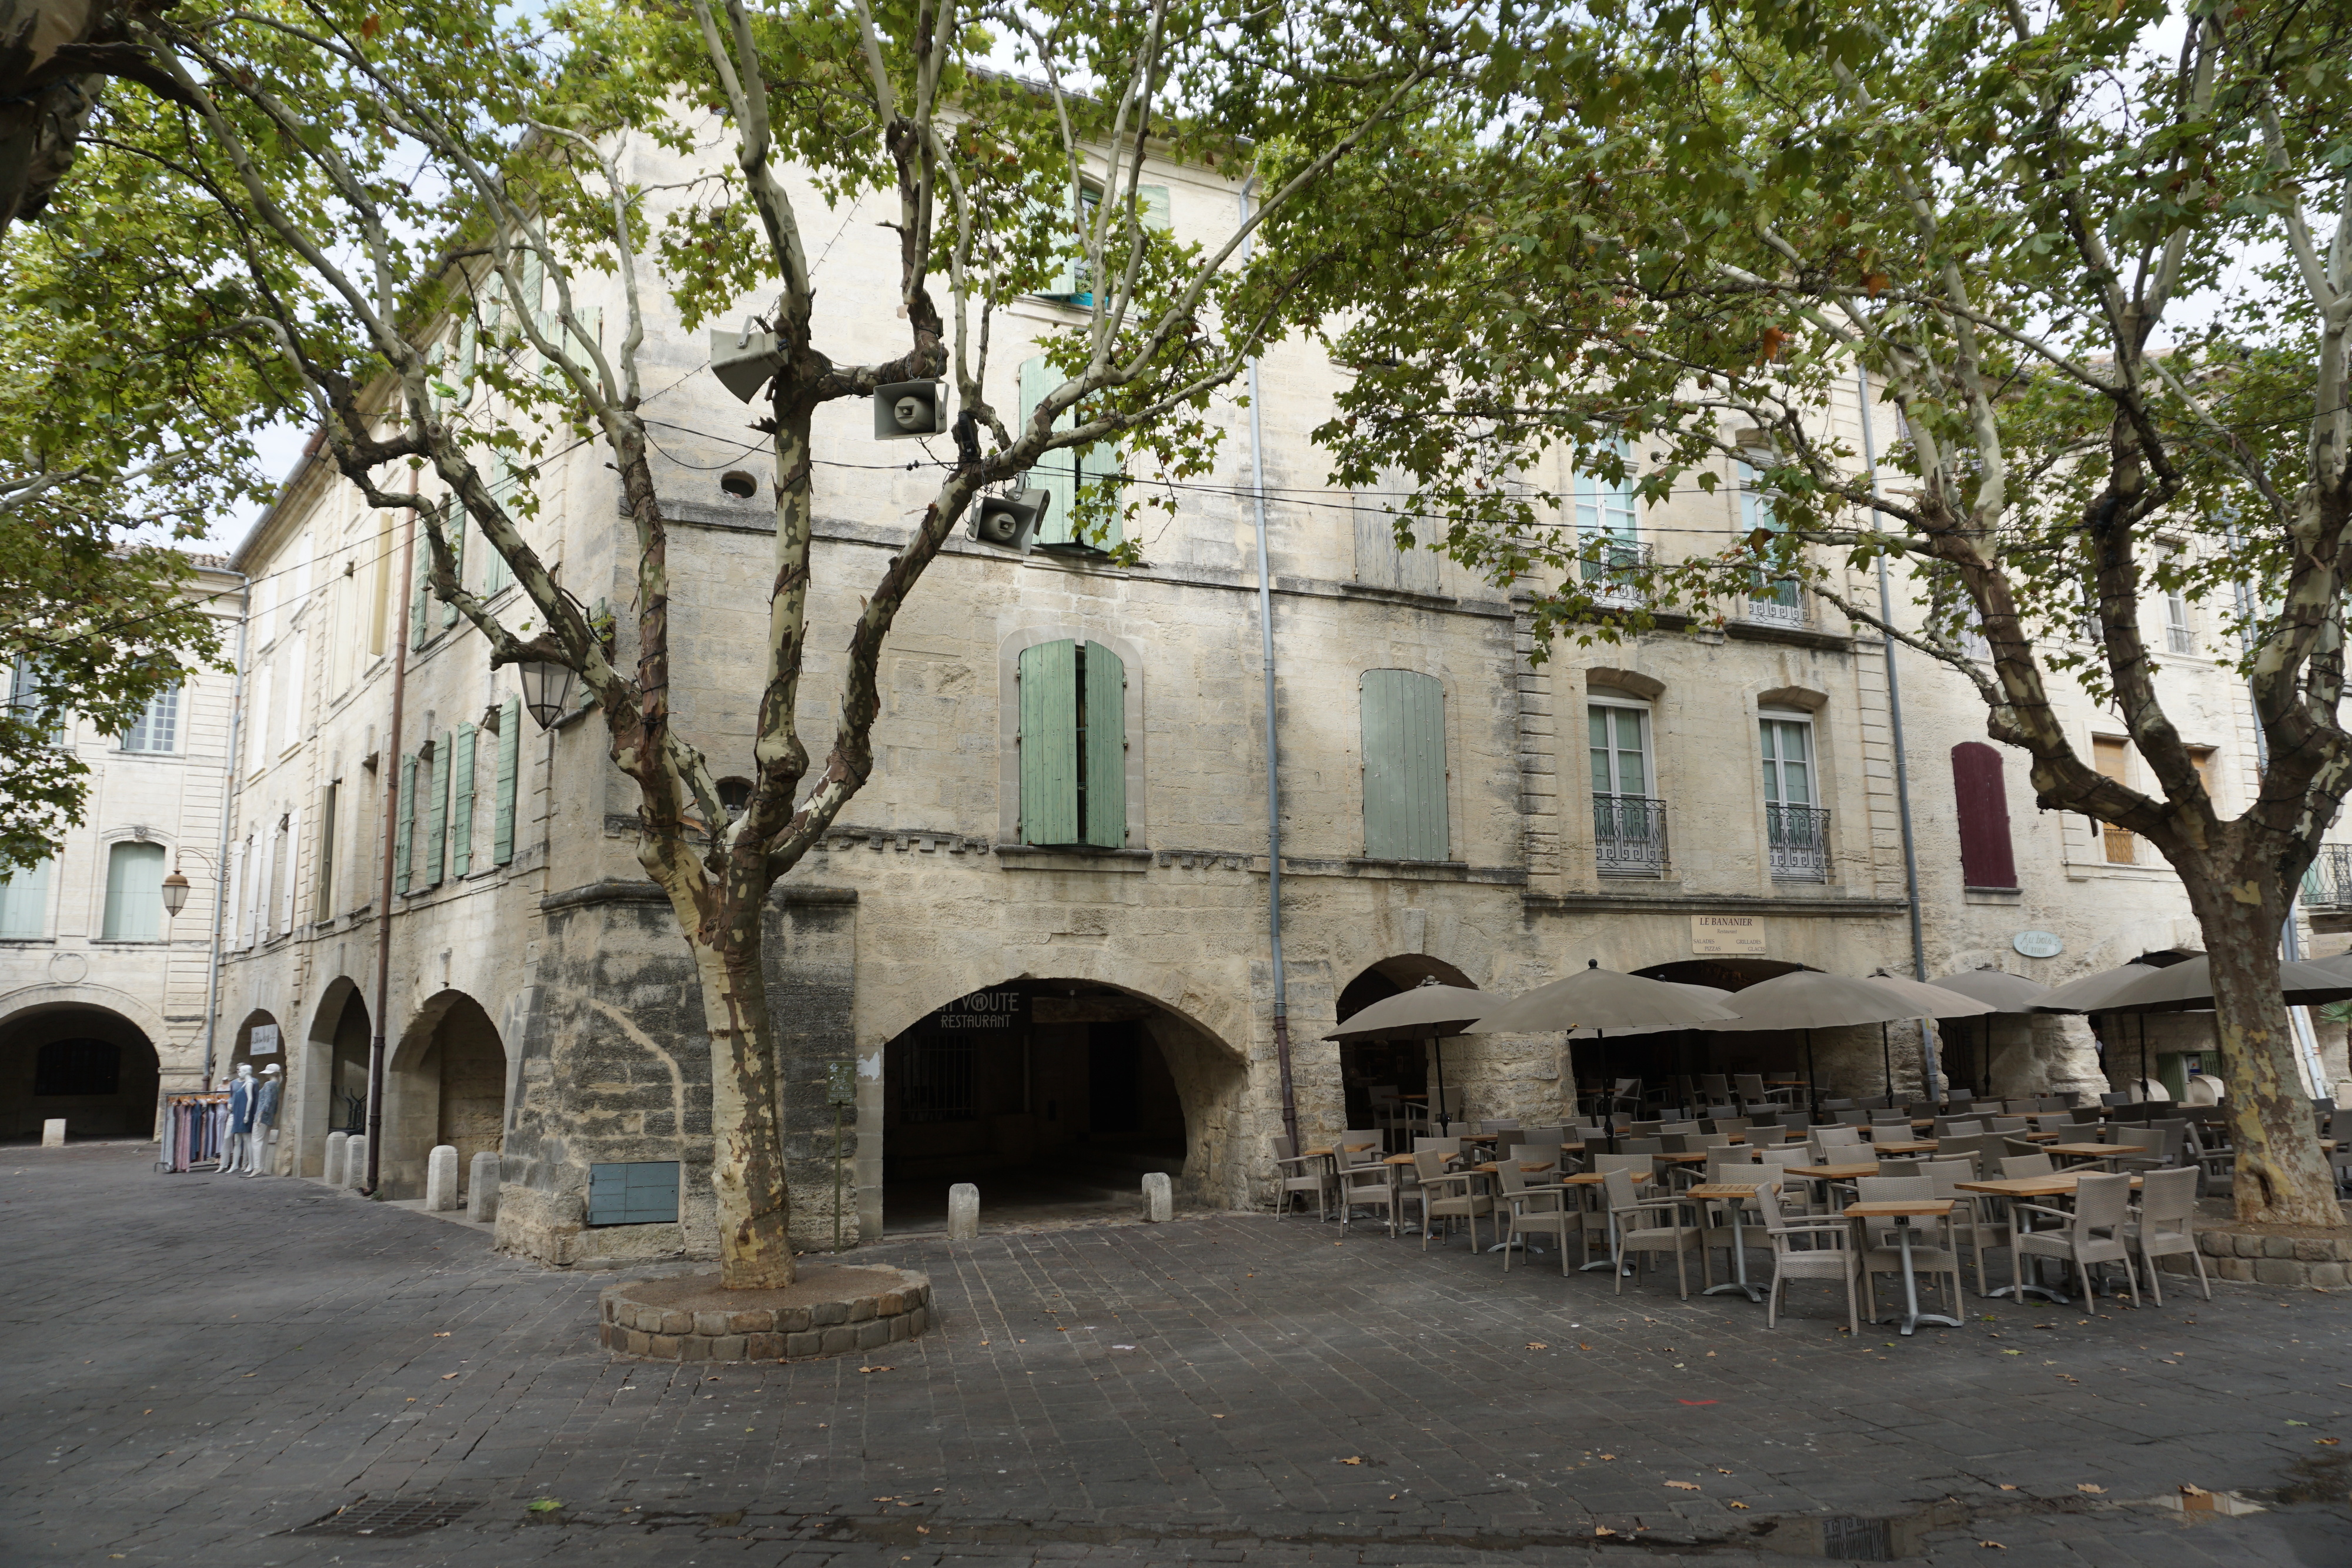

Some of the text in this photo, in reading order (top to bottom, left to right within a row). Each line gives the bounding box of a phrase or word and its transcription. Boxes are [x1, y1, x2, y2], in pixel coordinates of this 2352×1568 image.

[1699, 917, 1752, 926] LE BANANIER
[2022, 933, 2052, 944] Au bois
[961, 992, 1019, 1012] VOUTE
[941, 1014, 1011, 1028] RESTAURANT
